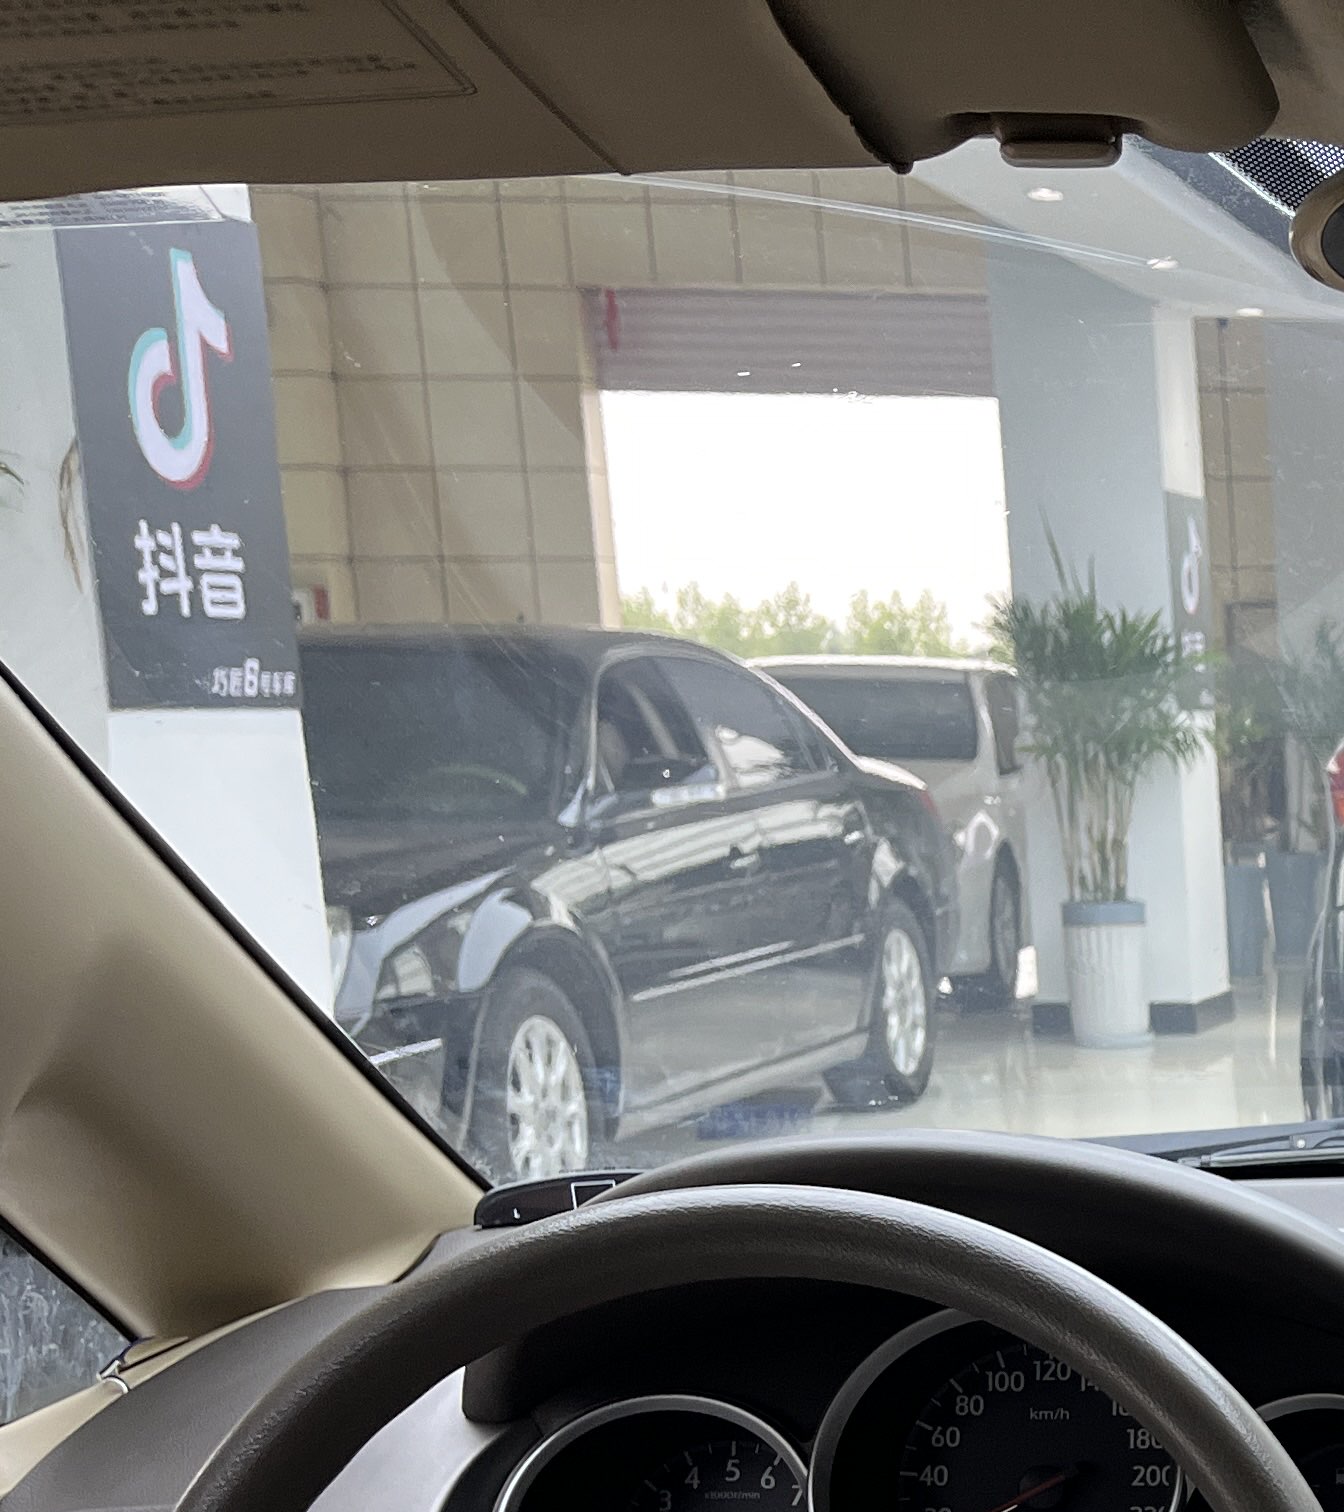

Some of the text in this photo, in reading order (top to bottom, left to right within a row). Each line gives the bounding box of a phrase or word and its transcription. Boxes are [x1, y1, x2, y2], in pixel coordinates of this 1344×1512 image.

[134, 518, 246, 620] 抖音
[985, 1370, 1026, 1393] 100
[1033, 1359, 1072, 1382] 120
[955, 1395, 985, 1417] 80
[1029, 1407, 1071, 1422] km/h
[931, 1426, 961, 1448] 60
[684, 1466, 701, 1490] 4
[725, 1459, 741, 1482] 5
[760, 1466, 776, 1489] 6
[919, 1465, 949, 1487] 40
[659, 1490, 672, 1512] 3
